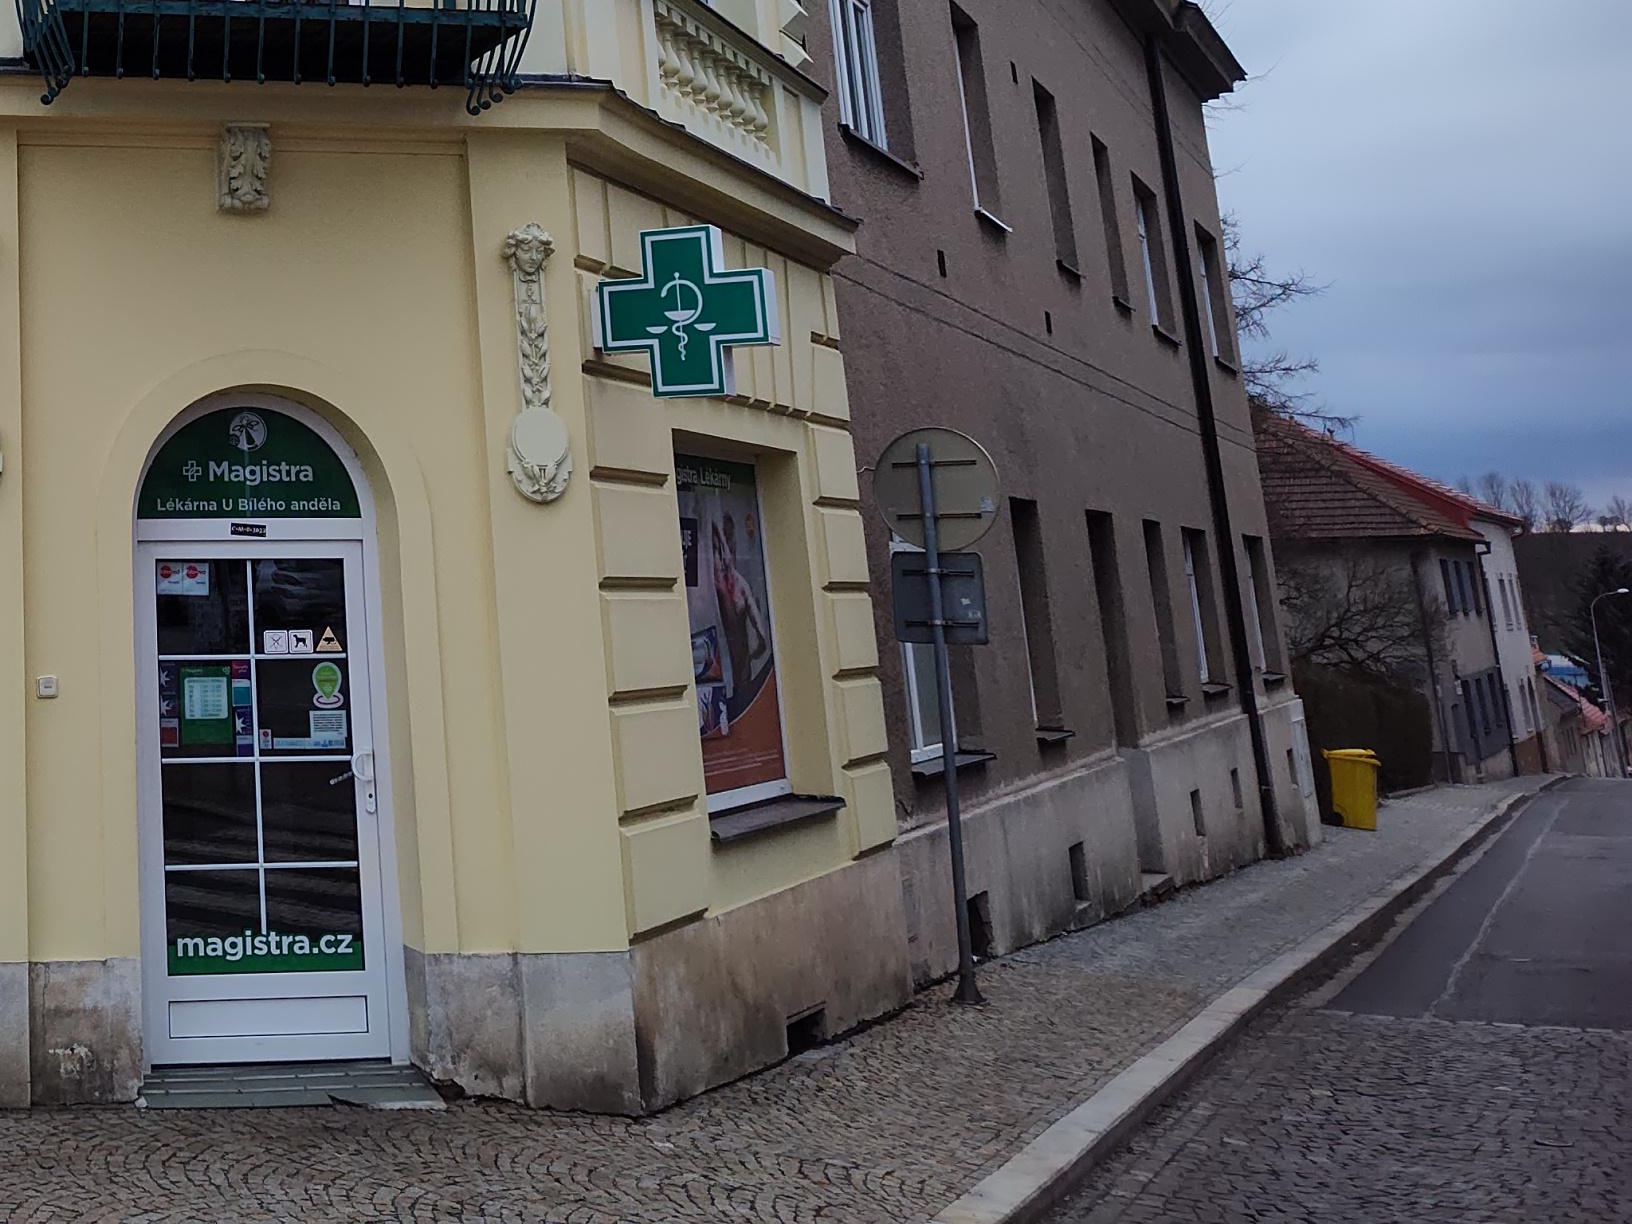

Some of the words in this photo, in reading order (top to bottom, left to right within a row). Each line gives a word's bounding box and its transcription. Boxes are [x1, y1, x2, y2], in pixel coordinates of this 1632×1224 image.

[209, 460, 314, 486] Magistra
[157, 497, 217, 511] Lékárna
[222, 499, 233, 511] U
[238, 497, 286, 511] Bílého
[290, 498, 341, 511] anděla
[177, 930, 353, 961] magistra.cz
